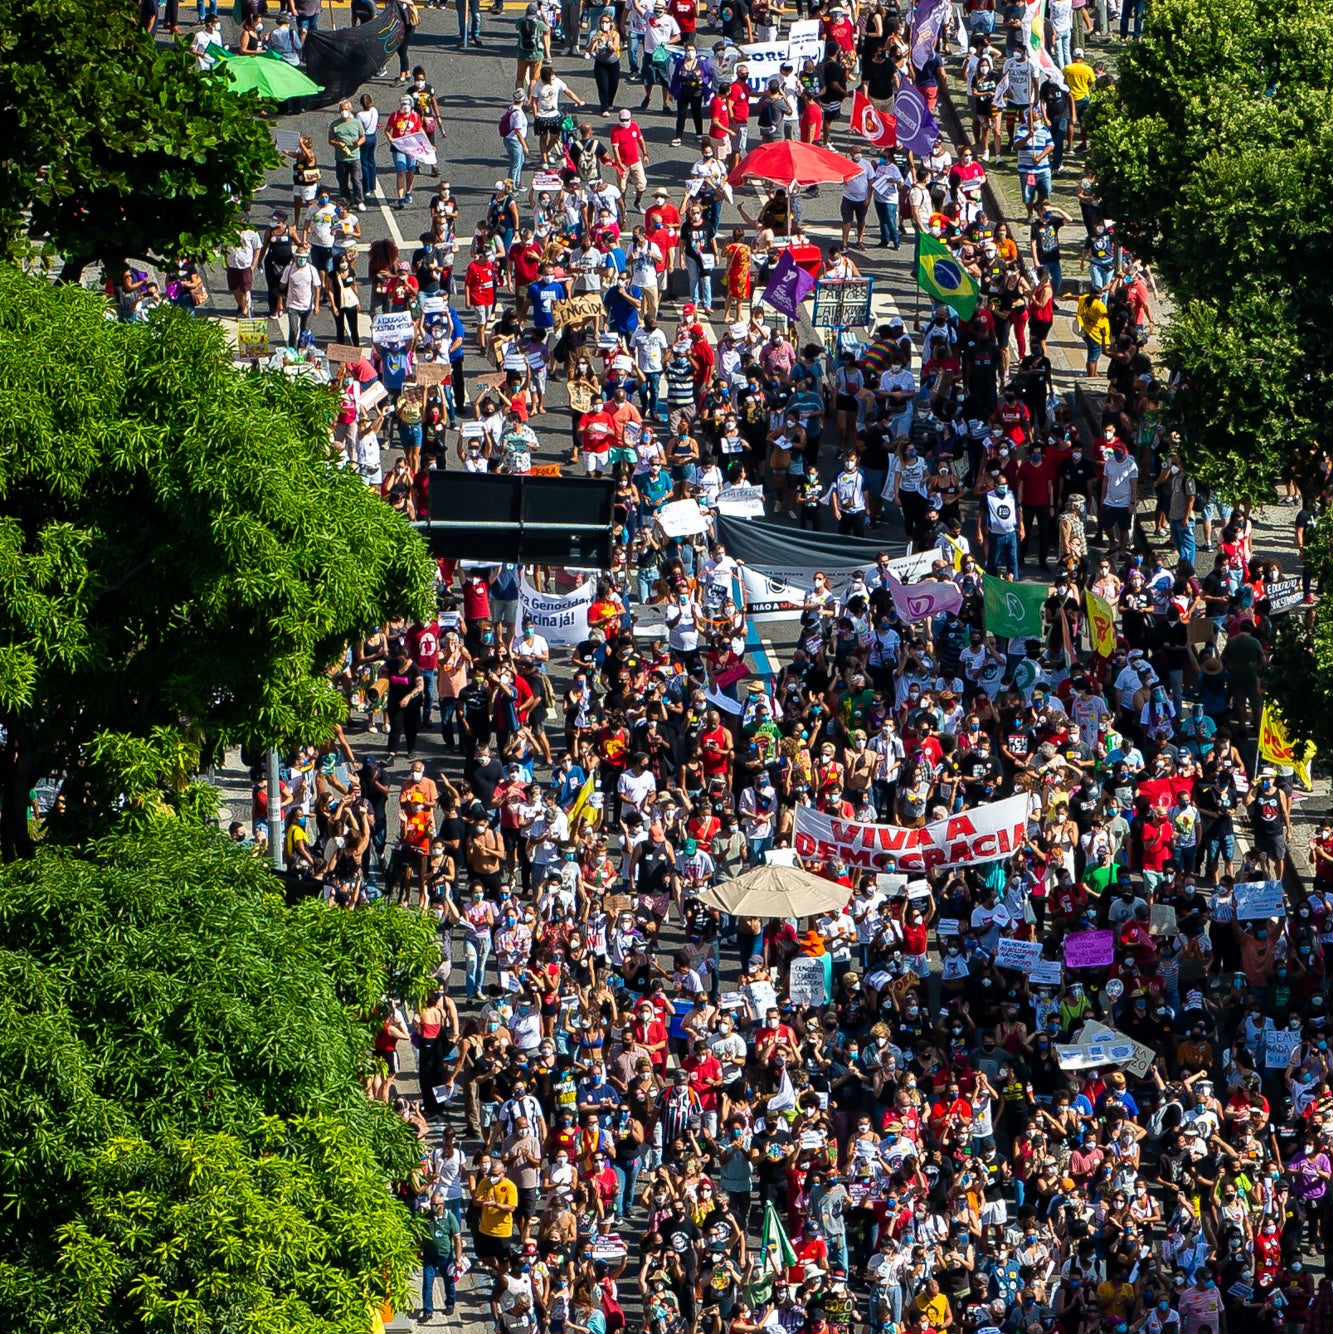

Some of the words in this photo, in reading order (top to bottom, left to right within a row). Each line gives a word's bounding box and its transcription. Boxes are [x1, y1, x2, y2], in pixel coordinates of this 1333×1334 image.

[558, 610, 576, 629] já!
[752, 602, 772, 612] NÃO
[795, 820, 1026, 873] DEMOCRACIA
[830, 819, 936, 852] VIVA
[945, 814, 978, 842] A
